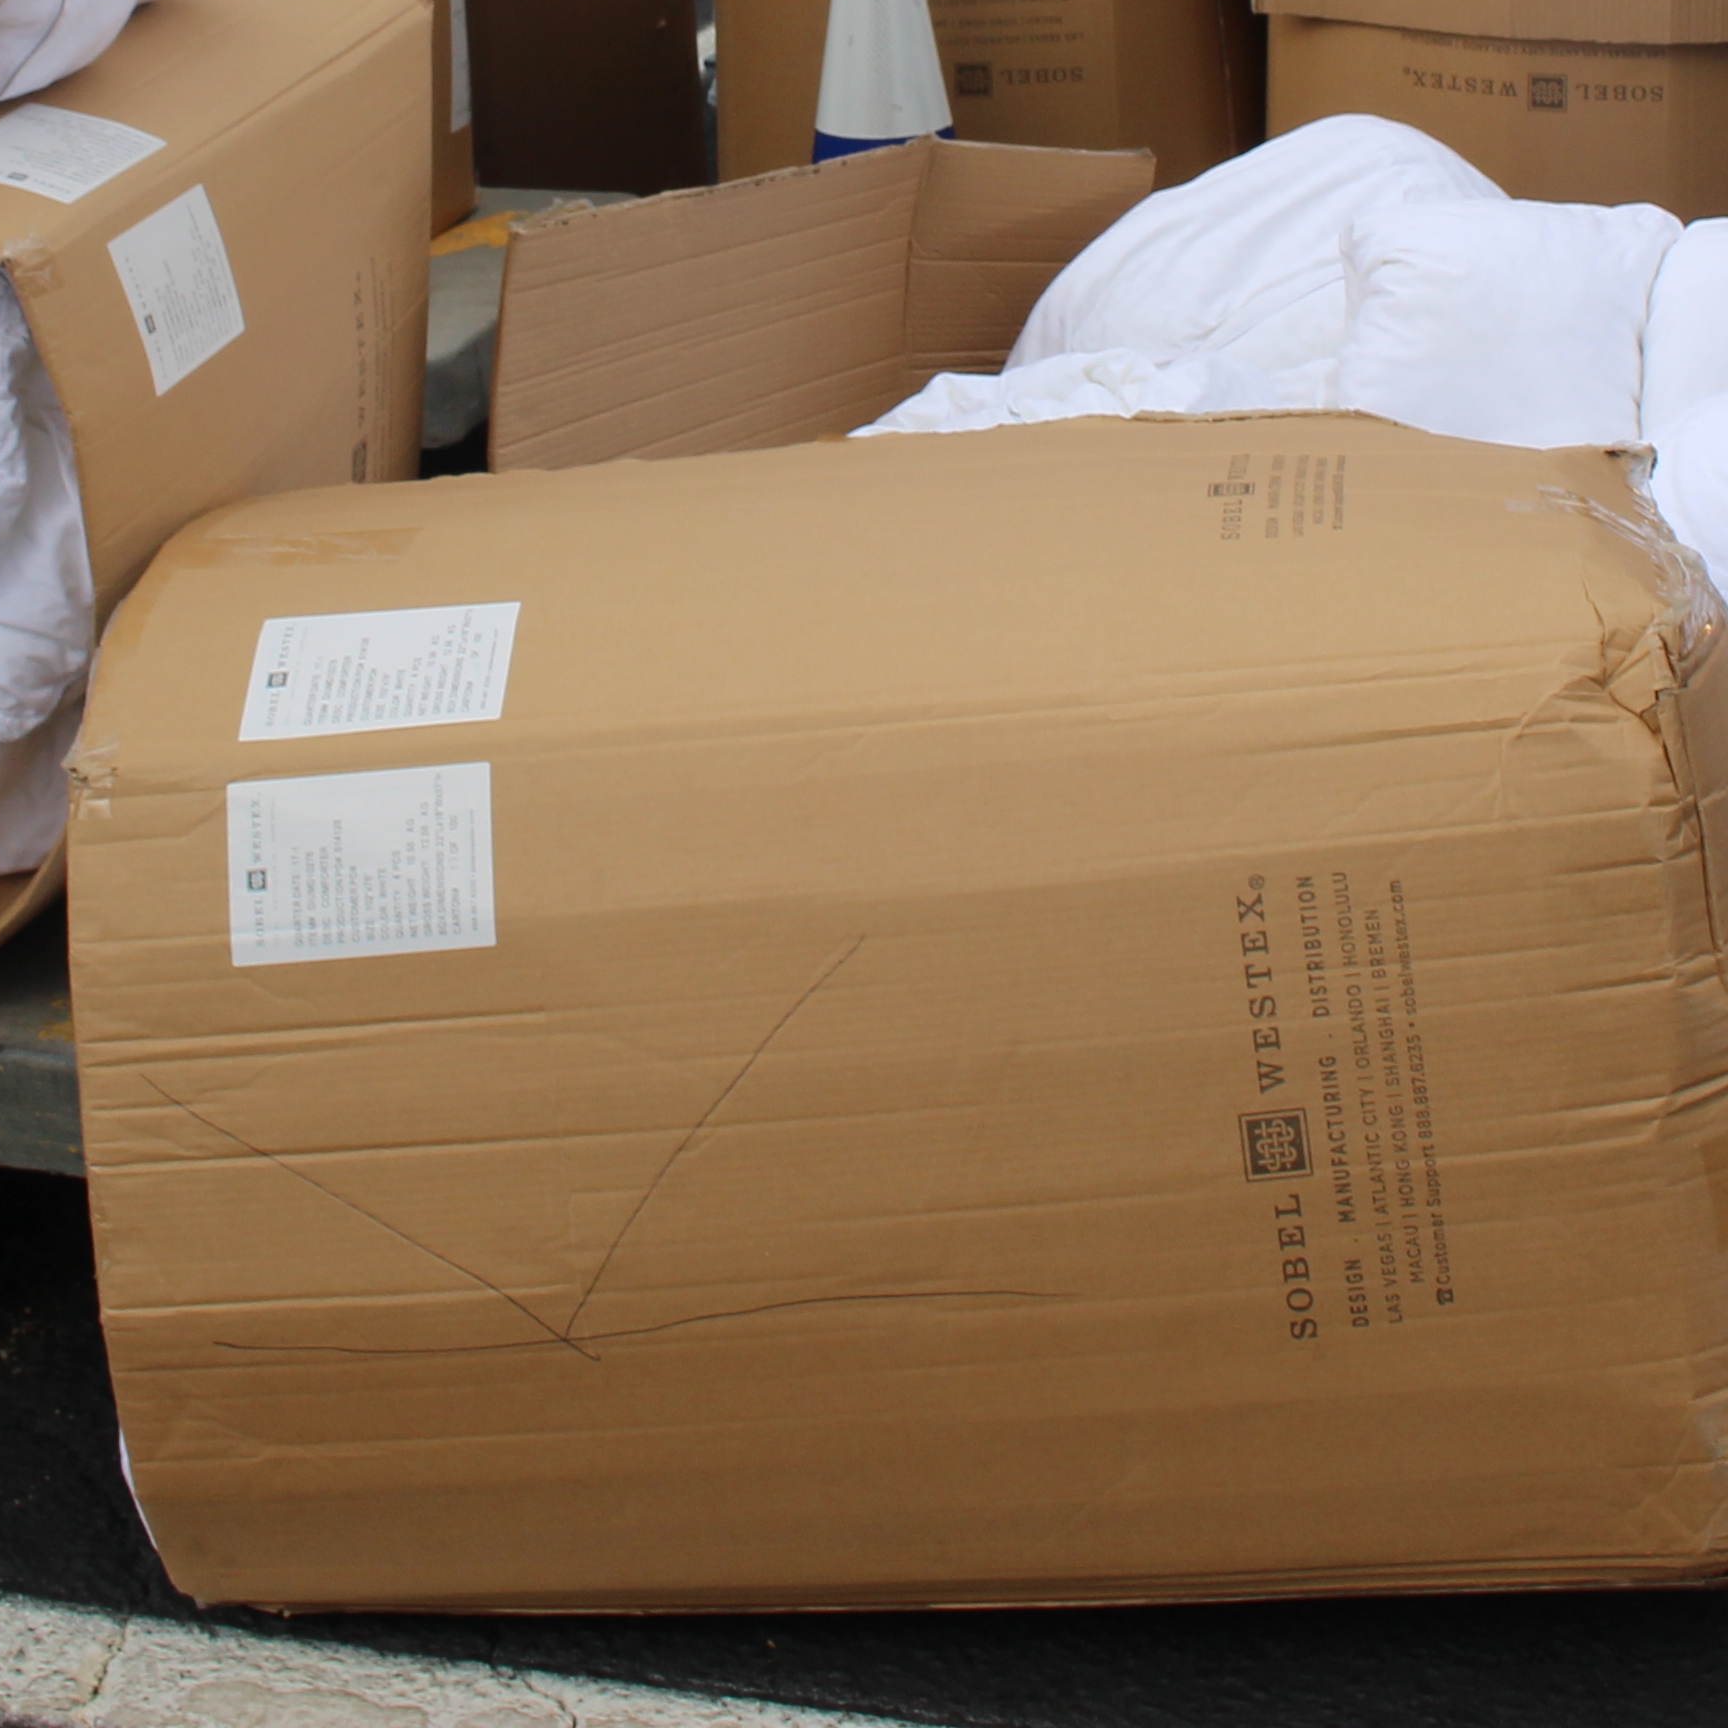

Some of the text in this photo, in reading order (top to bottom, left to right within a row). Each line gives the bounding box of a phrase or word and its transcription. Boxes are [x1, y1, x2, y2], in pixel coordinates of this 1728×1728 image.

[1000, 67, 1084, 86] SOBEL
[1575, 83, 1665, 103] SOBEL
[1278, 1193, 1318, 1342] SOBEL
[1298, 876, 1370, 1328] DESIGN MANUFACTURING DISTRIBUTION
[1335, 872, 1404, 1325] LAS VEGAS ATLANTIC CITY ORLANDO HONOLULU
[1367, 909, 1426, 1284] MACAU HONG KONG SHANGHAI BREMEN
[1391, 878, 1453, 1285] Customer Support 888.887.6235 sobelwestex.com
